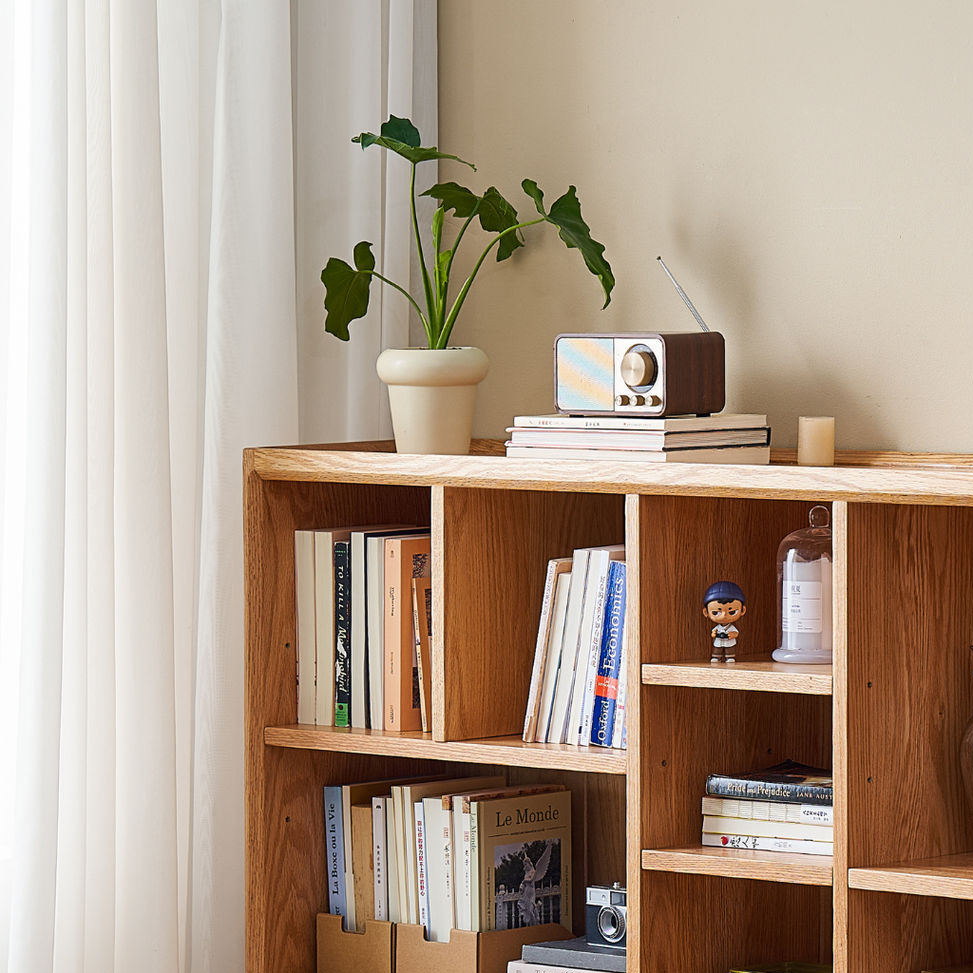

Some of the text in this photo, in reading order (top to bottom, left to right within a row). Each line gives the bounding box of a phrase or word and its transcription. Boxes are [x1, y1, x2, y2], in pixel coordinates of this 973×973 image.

[338, 565, 344, 579] TO
[603, 577, 624, 671] Economics
[597, 700, 610, 741] Oxford
[726, 782, 746, 793] Pride
[757, 785, 791, 798] Prejudice
[796, 791, 813, 799] JANE
[496, 805, 559, 828] Le Monde
[329, 824, 336, 833] la
[331, 836, 337, 849] ou
[332, 881, 339, 895] La
